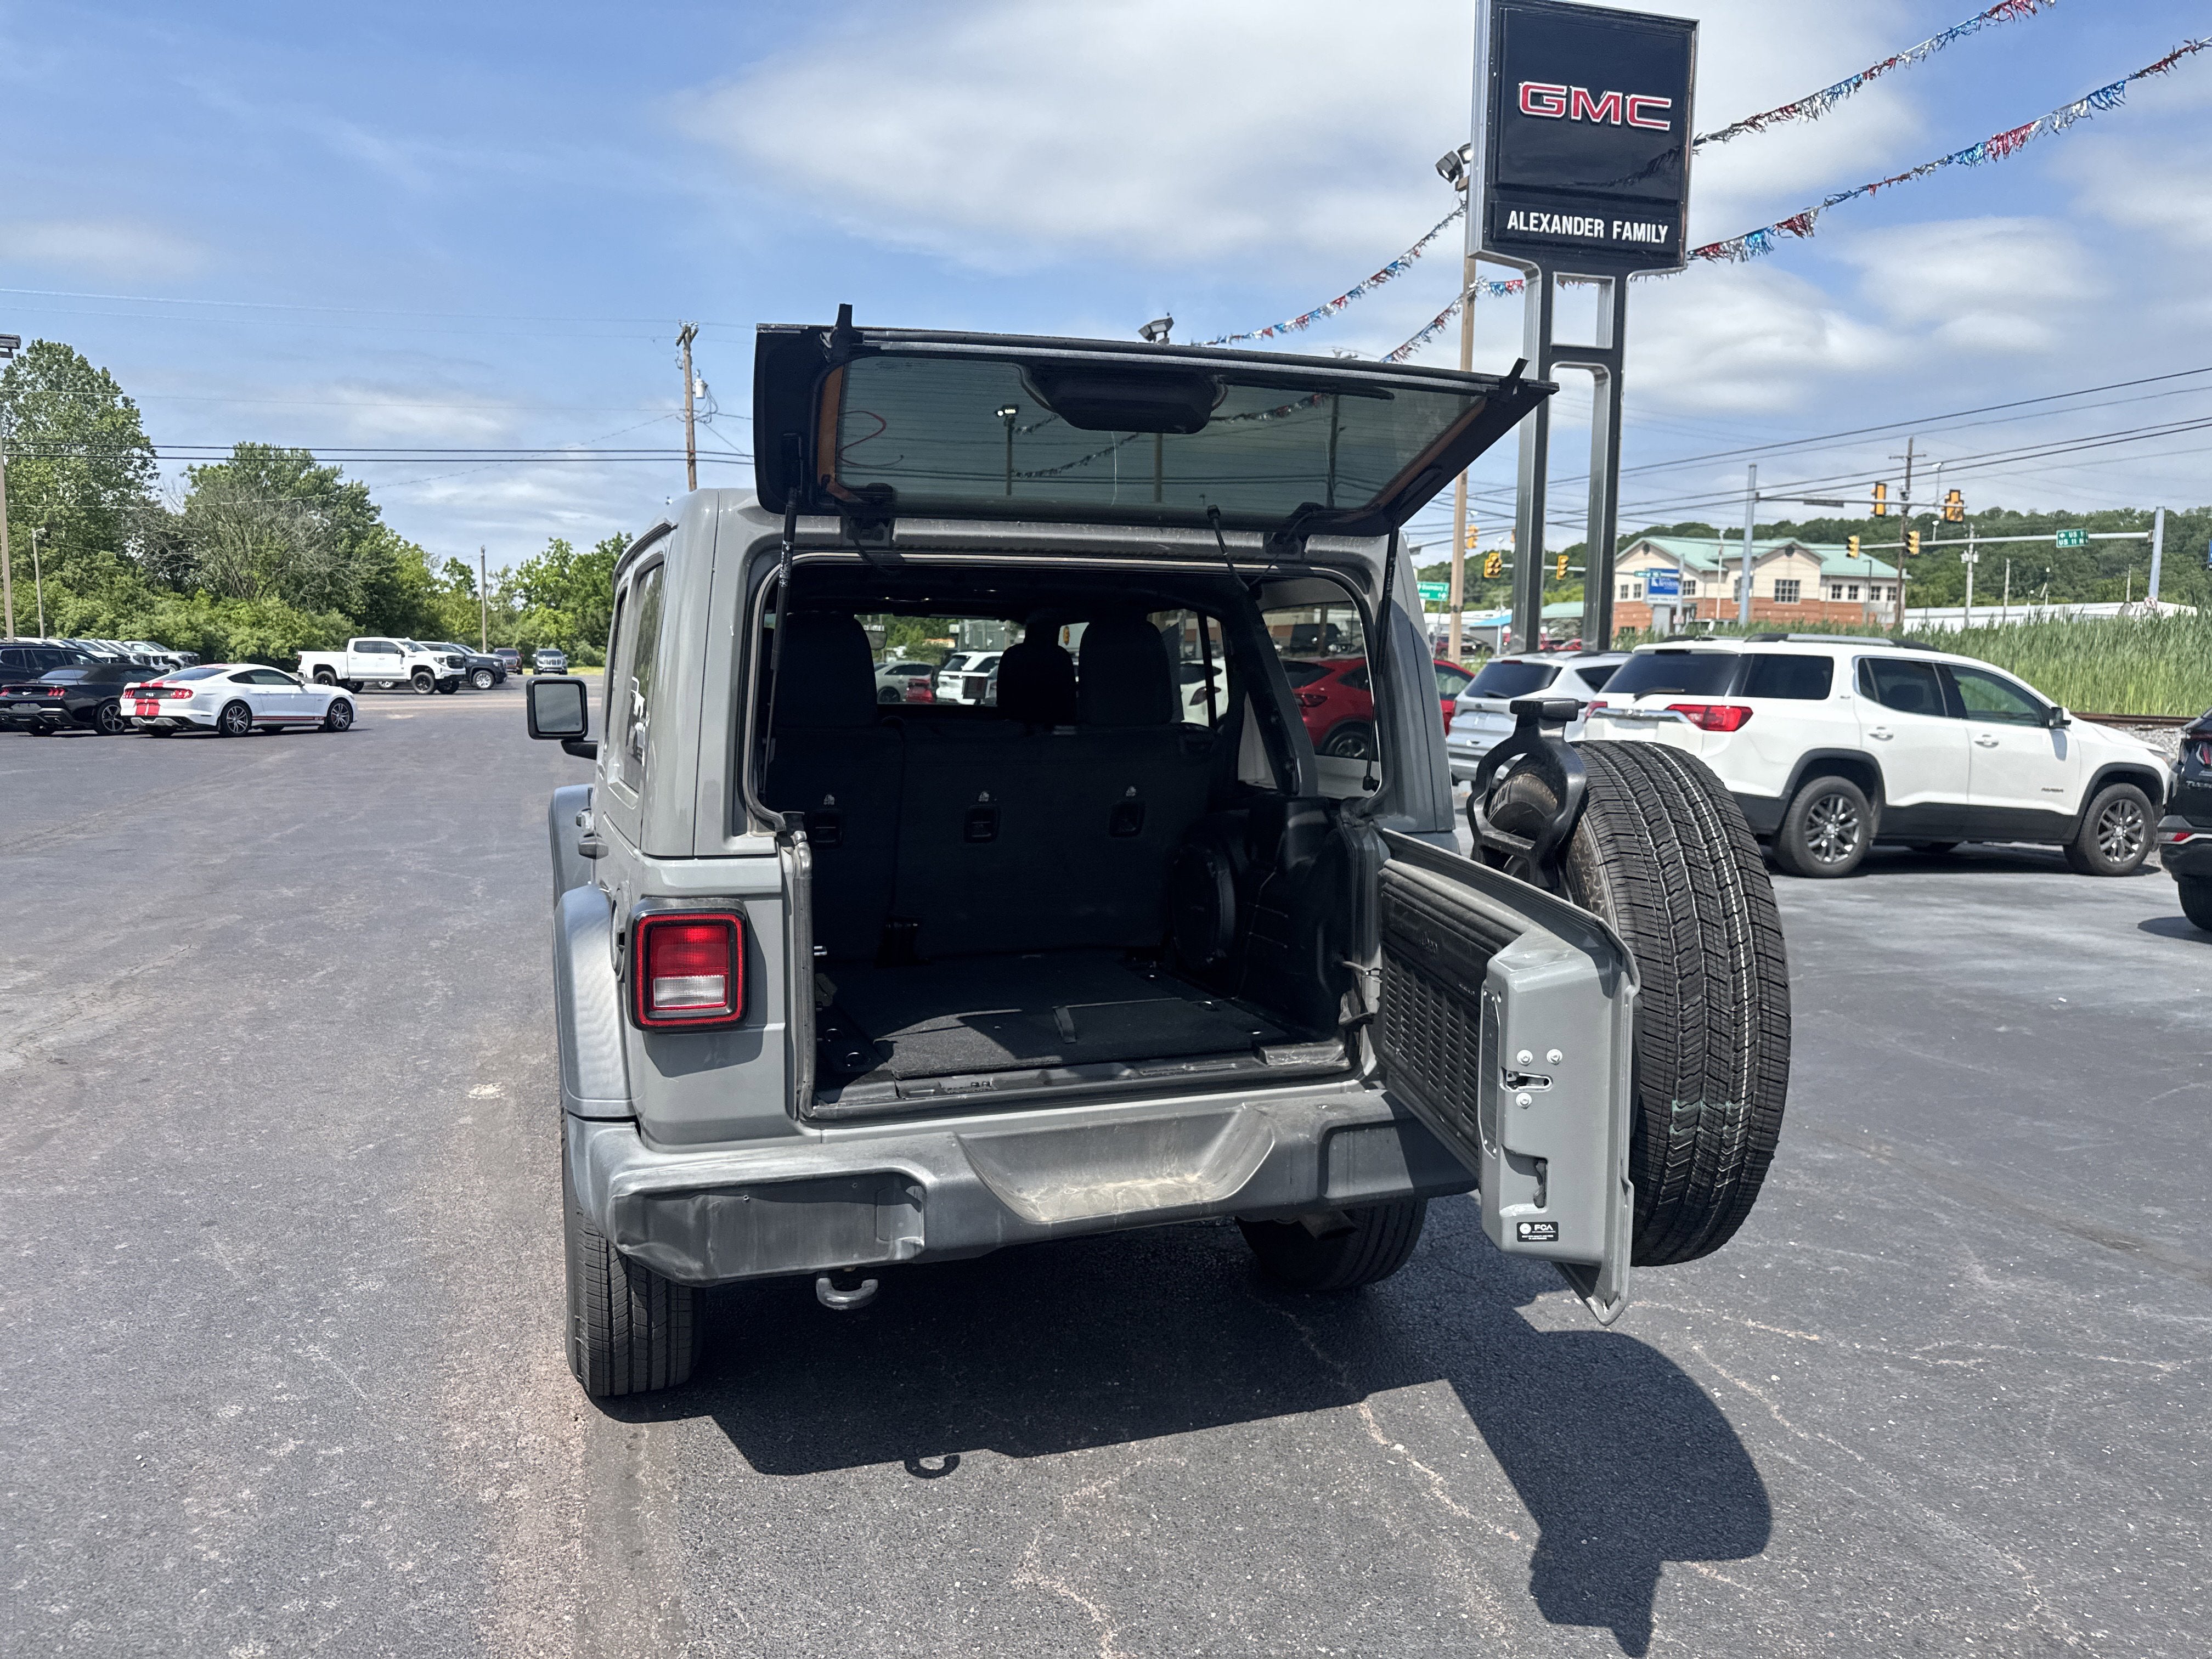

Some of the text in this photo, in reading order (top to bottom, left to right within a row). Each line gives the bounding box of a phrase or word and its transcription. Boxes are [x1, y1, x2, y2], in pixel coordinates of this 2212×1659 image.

[1519, 81, 1672, 131] GMC
[1507, 211, 1668, 243] ALEXANDER FAMILY
